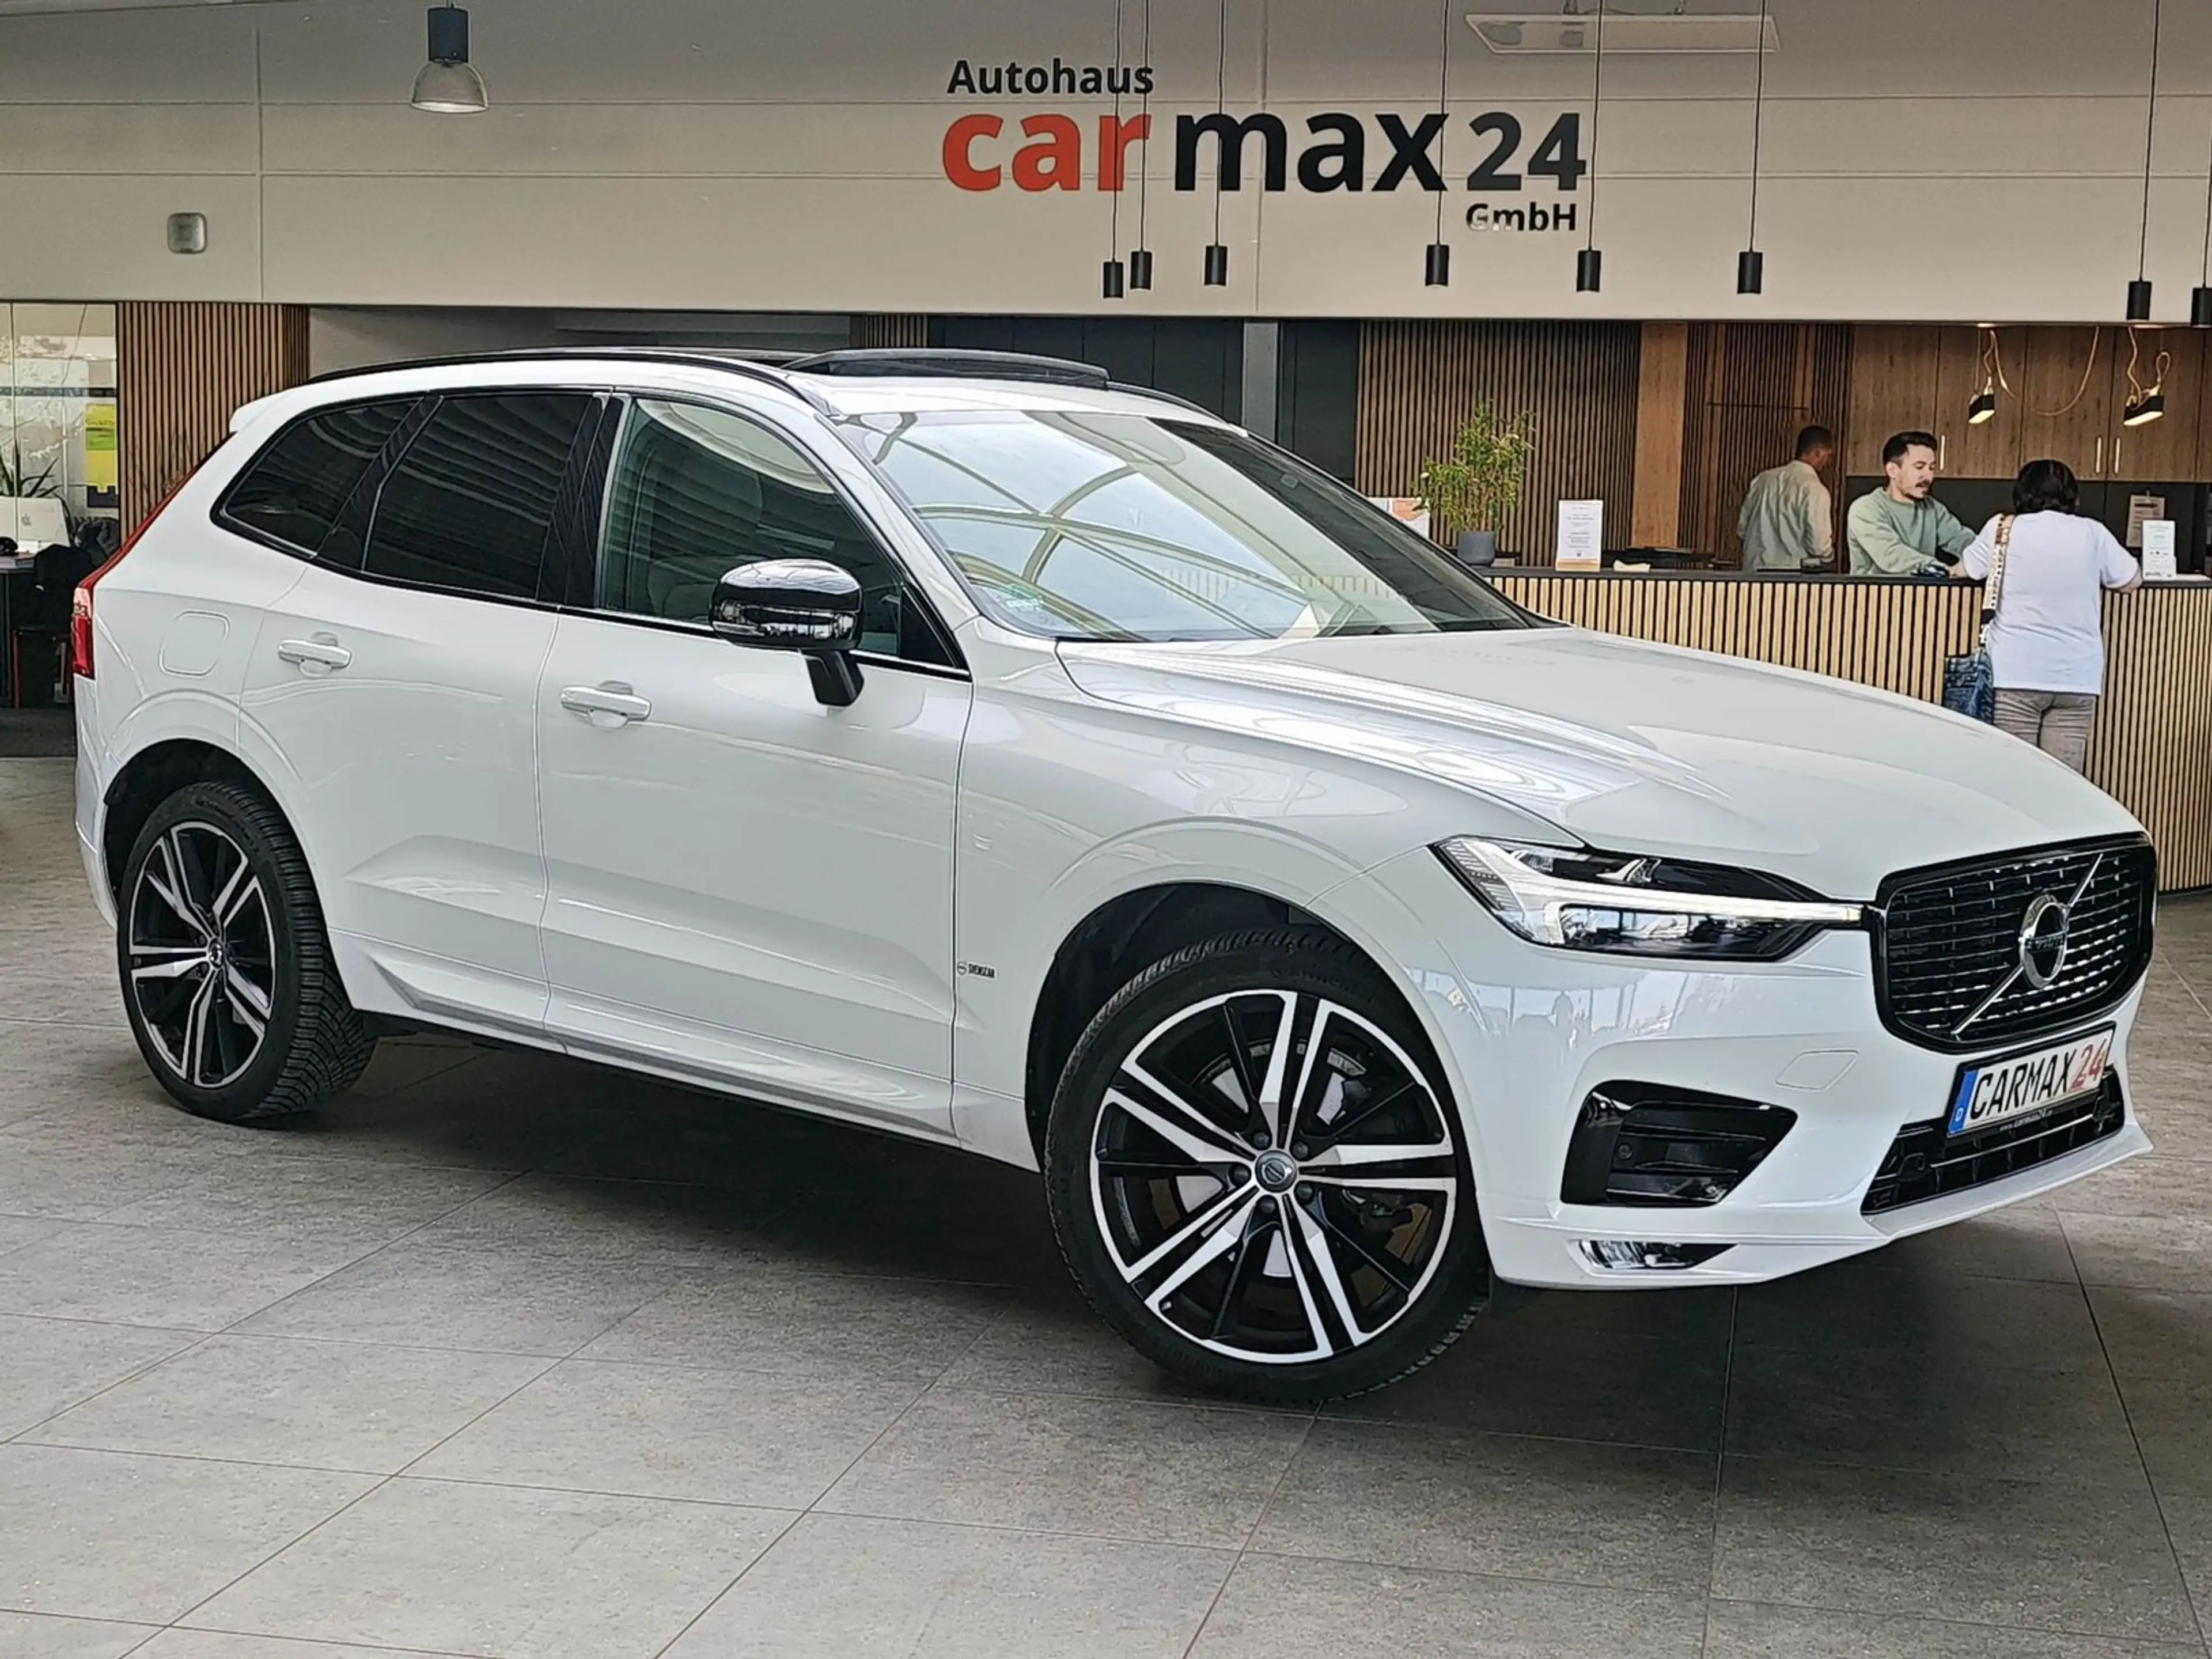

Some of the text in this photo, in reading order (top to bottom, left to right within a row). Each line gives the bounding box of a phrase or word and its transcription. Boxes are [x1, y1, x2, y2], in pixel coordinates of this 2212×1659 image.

[947, 58, 1153, 94] Autohaus
[1467, 111, 1586, 191] 24
[1466, 202, 1577, 231] GmbH
